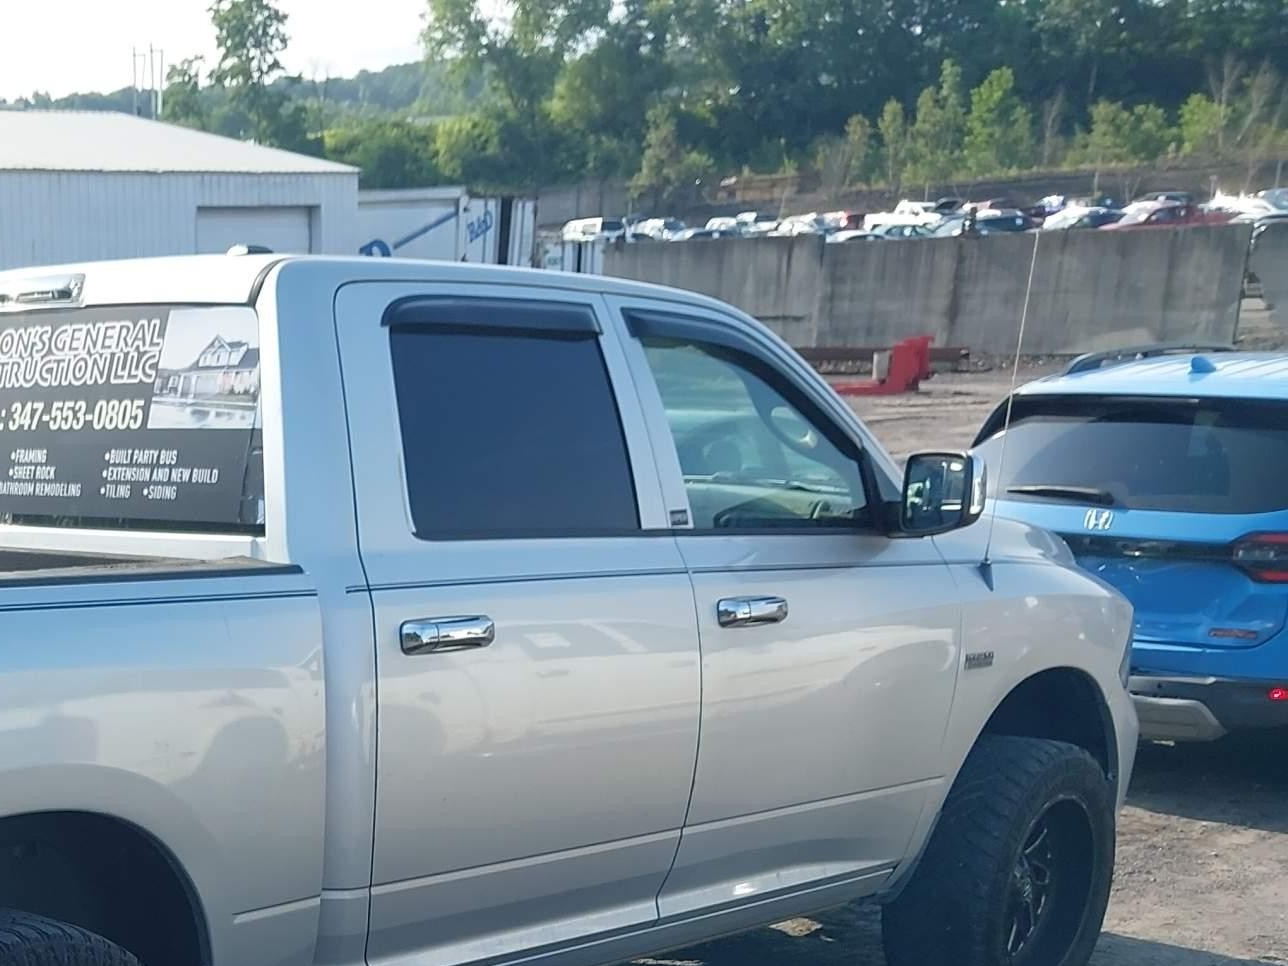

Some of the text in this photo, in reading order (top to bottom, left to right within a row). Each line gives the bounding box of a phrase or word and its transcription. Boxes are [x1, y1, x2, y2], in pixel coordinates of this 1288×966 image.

[51, 318, 163, 356] GENERAL
[110, 351, 159, 384] LLC
[8, 399, 145, 431] 347-553-0805
[15, 448, 48, 463] FRAMING
[110, 448, 178, 465] BUILT PARTY BUS
[13, 464, 57, 480] SHEET ROCK
[107, 466, 219, 484] EXTENSION AND NEW BUILD
[34, 482, 82, 497] REMODELING
[105, 483, 131, 499] TILING
[148, 485, 178, 500] SIDING
